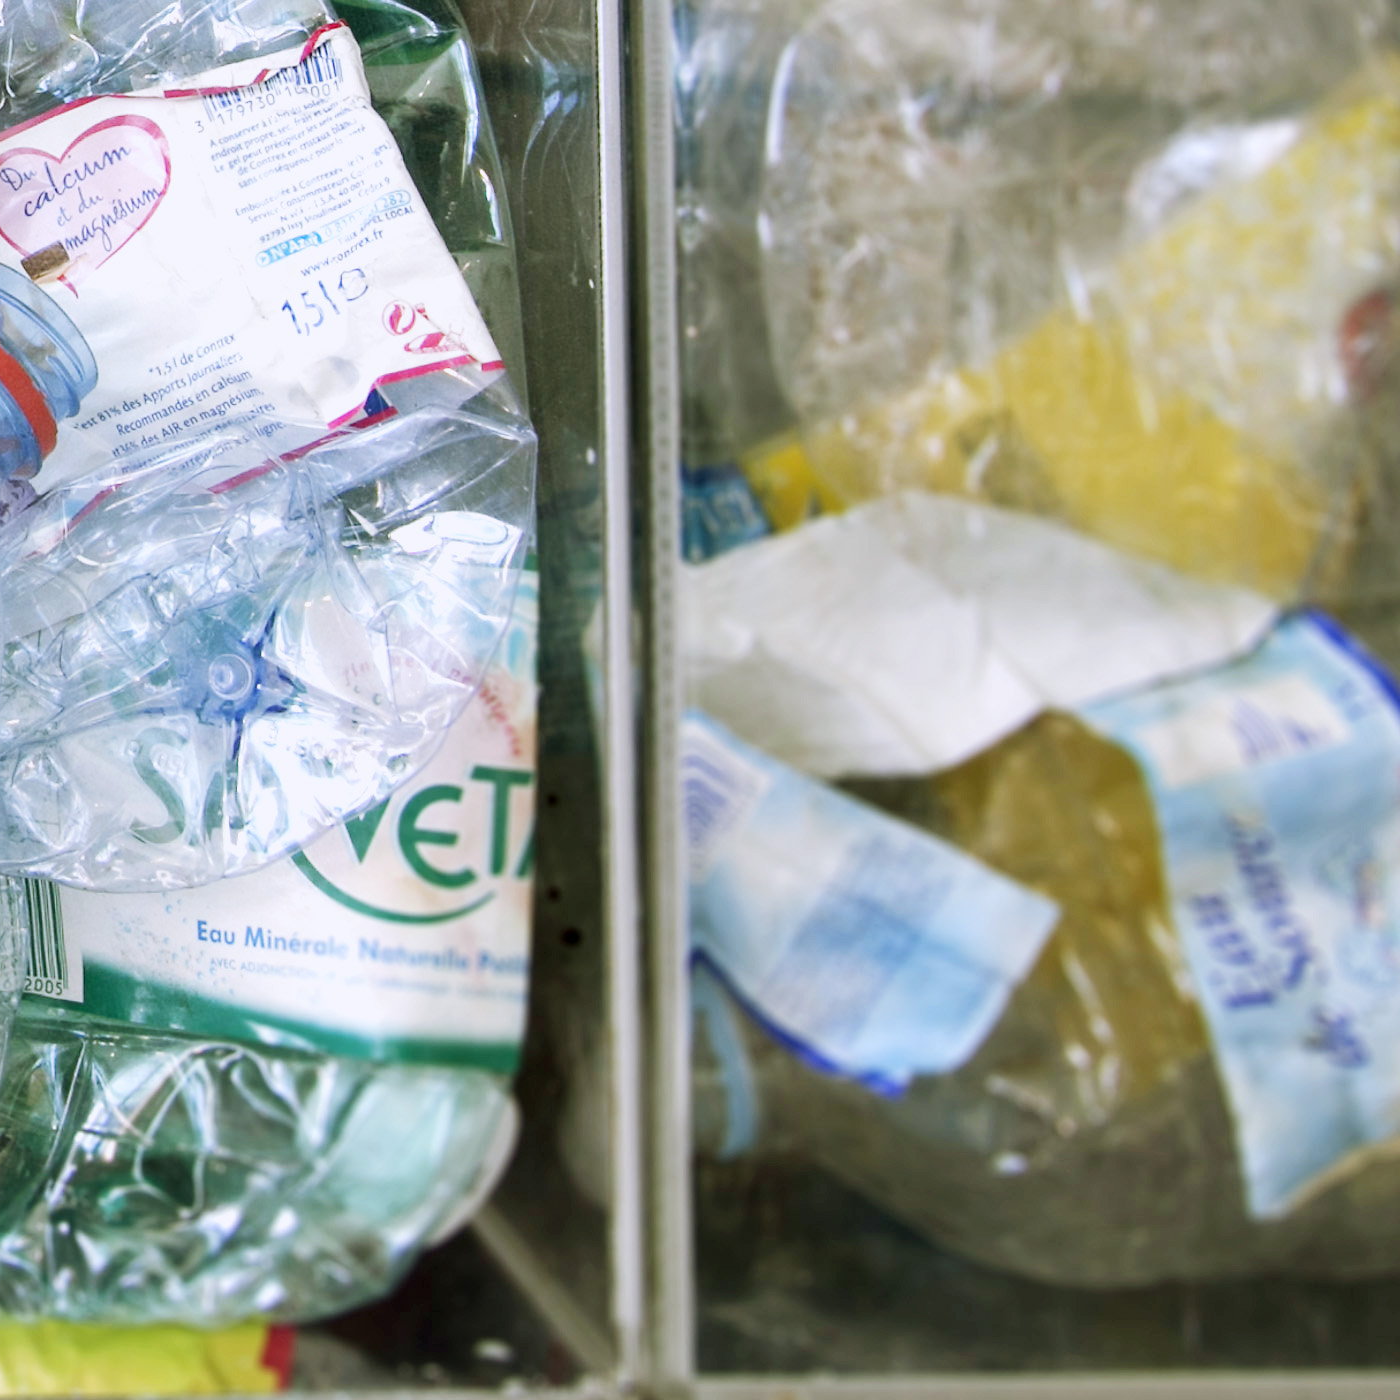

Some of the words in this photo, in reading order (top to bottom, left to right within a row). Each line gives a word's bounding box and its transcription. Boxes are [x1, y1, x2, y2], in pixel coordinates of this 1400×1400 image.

[23, 144, 132, 217] calcium
[52, 204, 74, 227] et
[70, 179, 105, 213] du
[63, 185, 160, 252] magnésium
[116, 394, 195, 436] Recommandés
[193, 388, 210, 402] en
[208, 366, 252, 393] calcium
[182, 415, 198, 428] en
[197, 921, 234, 945] Eau
[245, 926, 349, 960] Minérale
